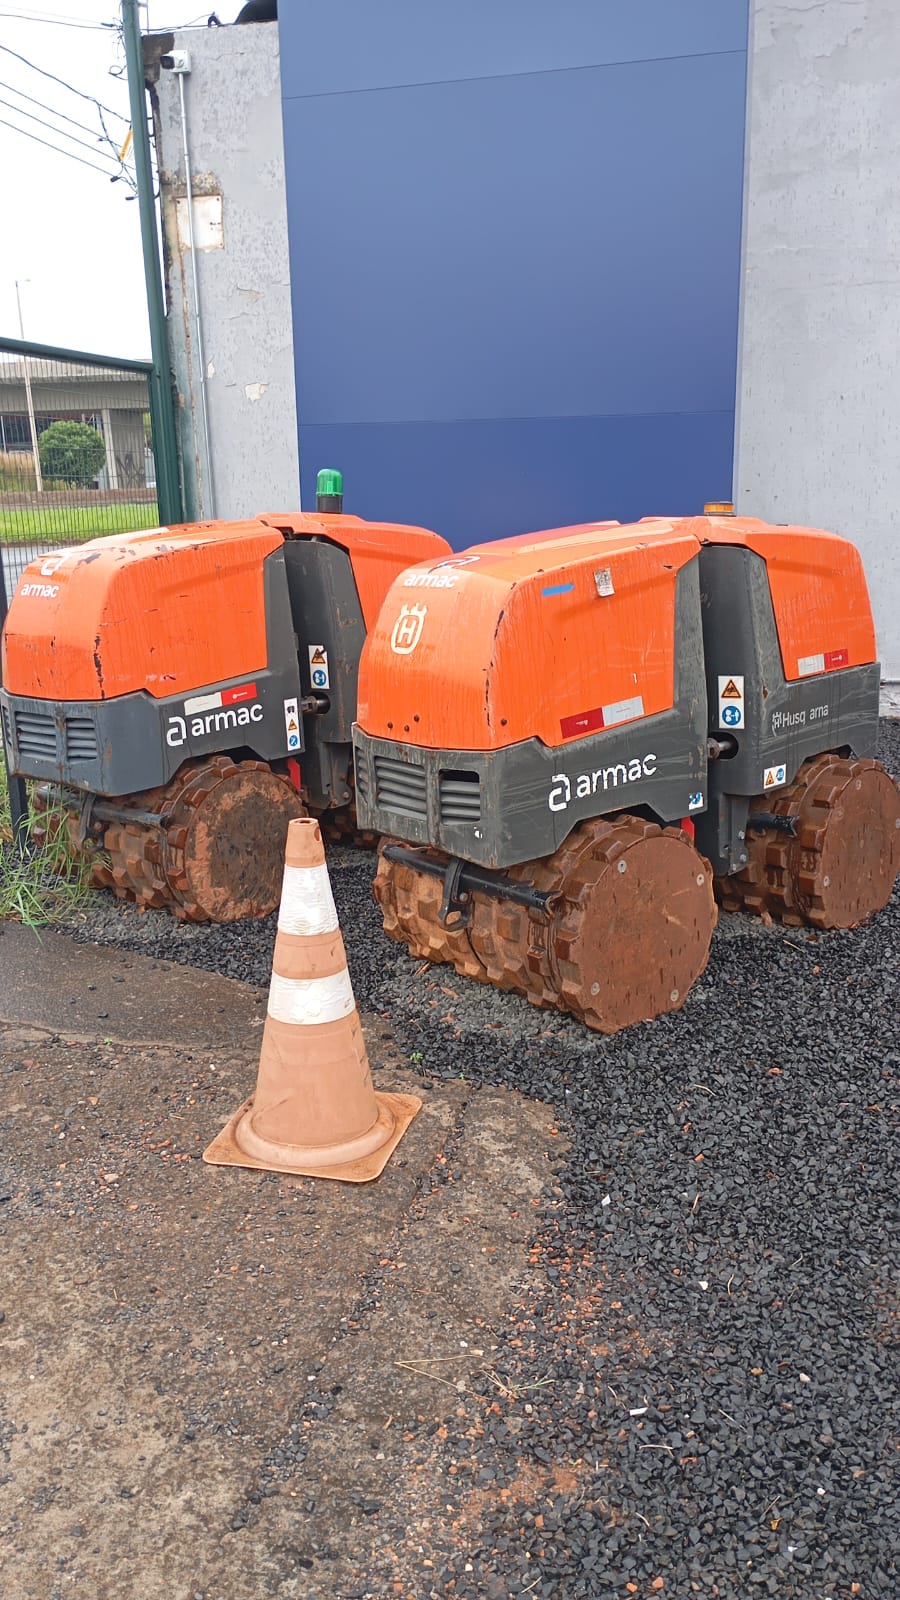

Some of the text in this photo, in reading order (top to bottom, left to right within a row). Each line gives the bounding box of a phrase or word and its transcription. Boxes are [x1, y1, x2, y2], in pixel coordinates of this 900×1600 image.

[21, 584, 60, 598] armac
[403, 574, 460, 588] armac
[191, 704, 264, 737] armac
[576, 753, 658, 798] armac
